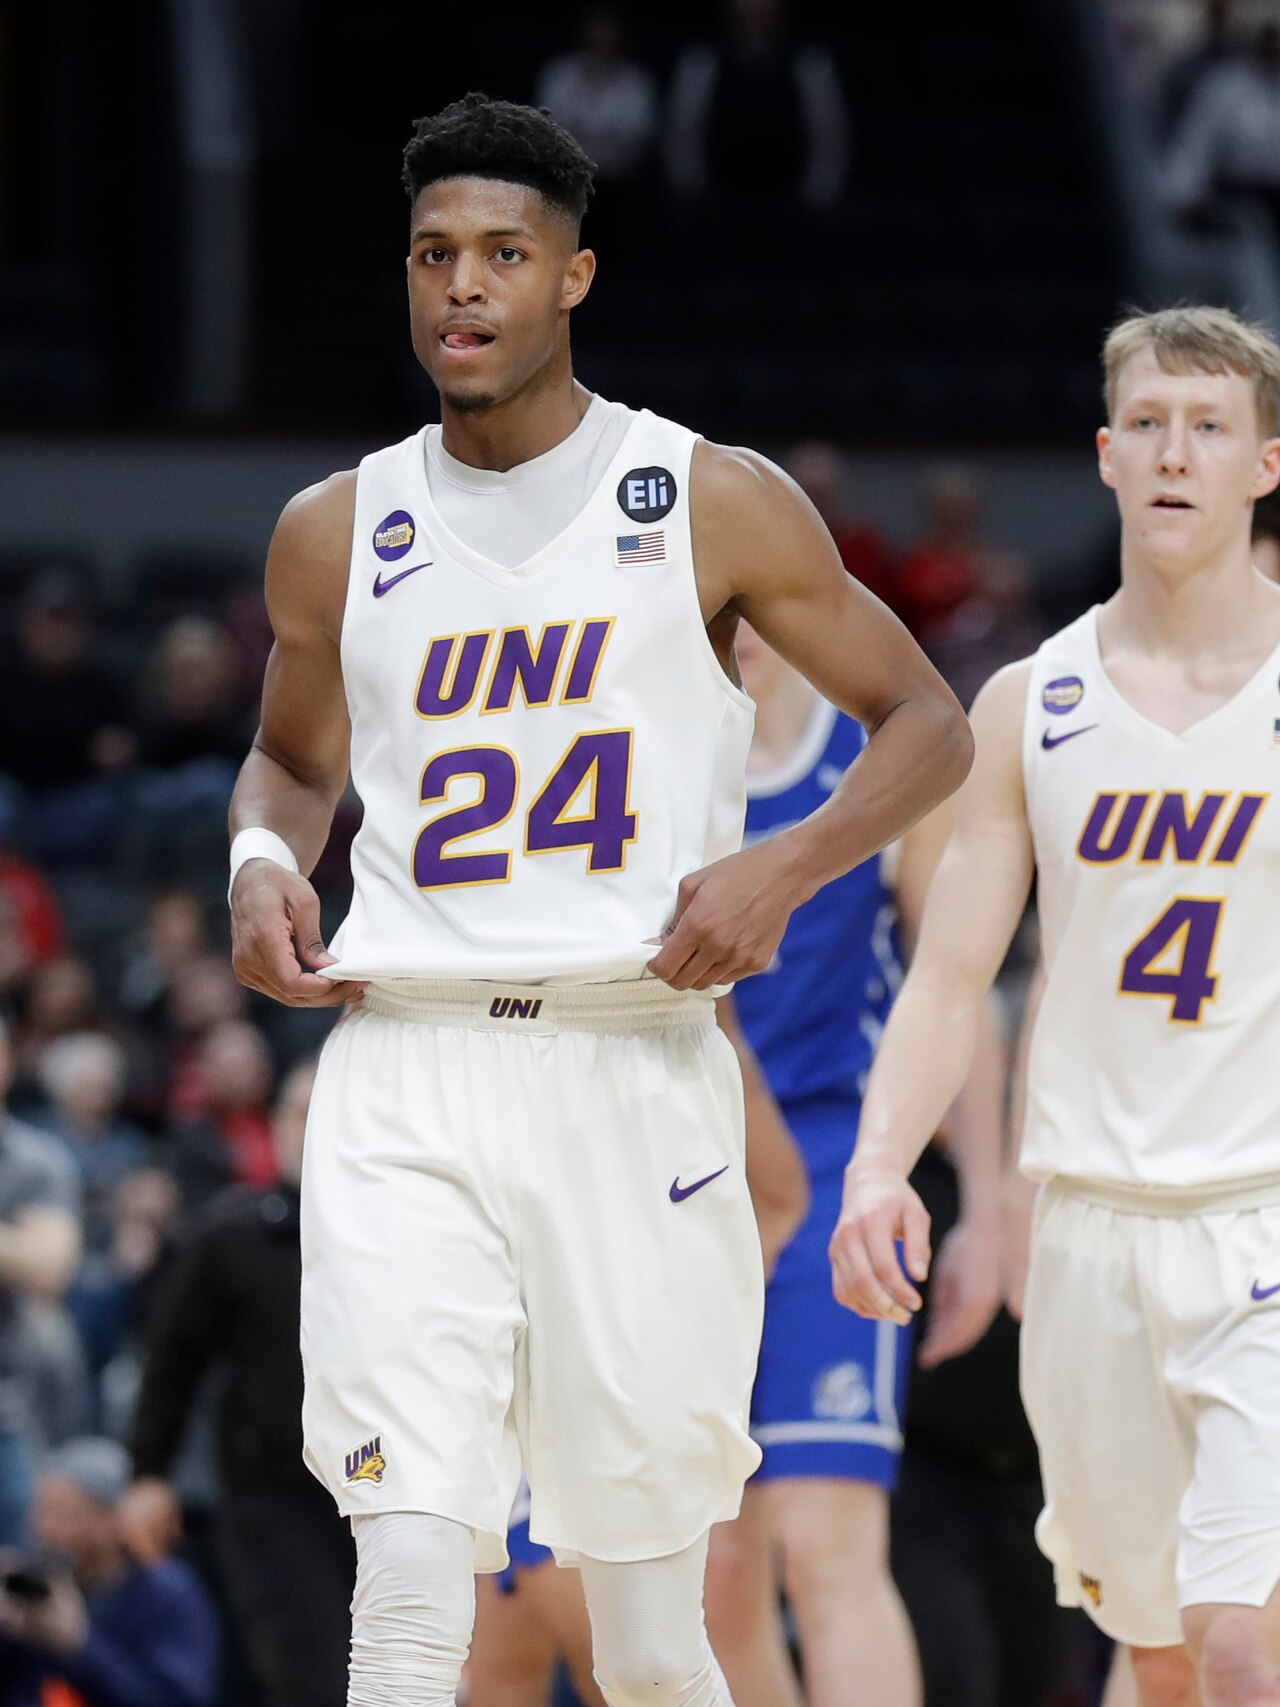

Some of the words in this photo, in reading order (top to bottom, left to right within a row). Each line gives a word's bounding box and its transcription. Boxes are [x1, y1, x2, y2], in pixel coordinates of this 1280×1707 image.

[627, 476, 668, 510] Eli
[413, 616, 617, 721] UNI
[412, 727, 640, 892] 24
[1075, 789, 1272, 868] UNI
[1116, 895, 1228, 1026] 4
[489, 997, 544, 1019] UNI
[344, 1435, 381, 1478] UNI
